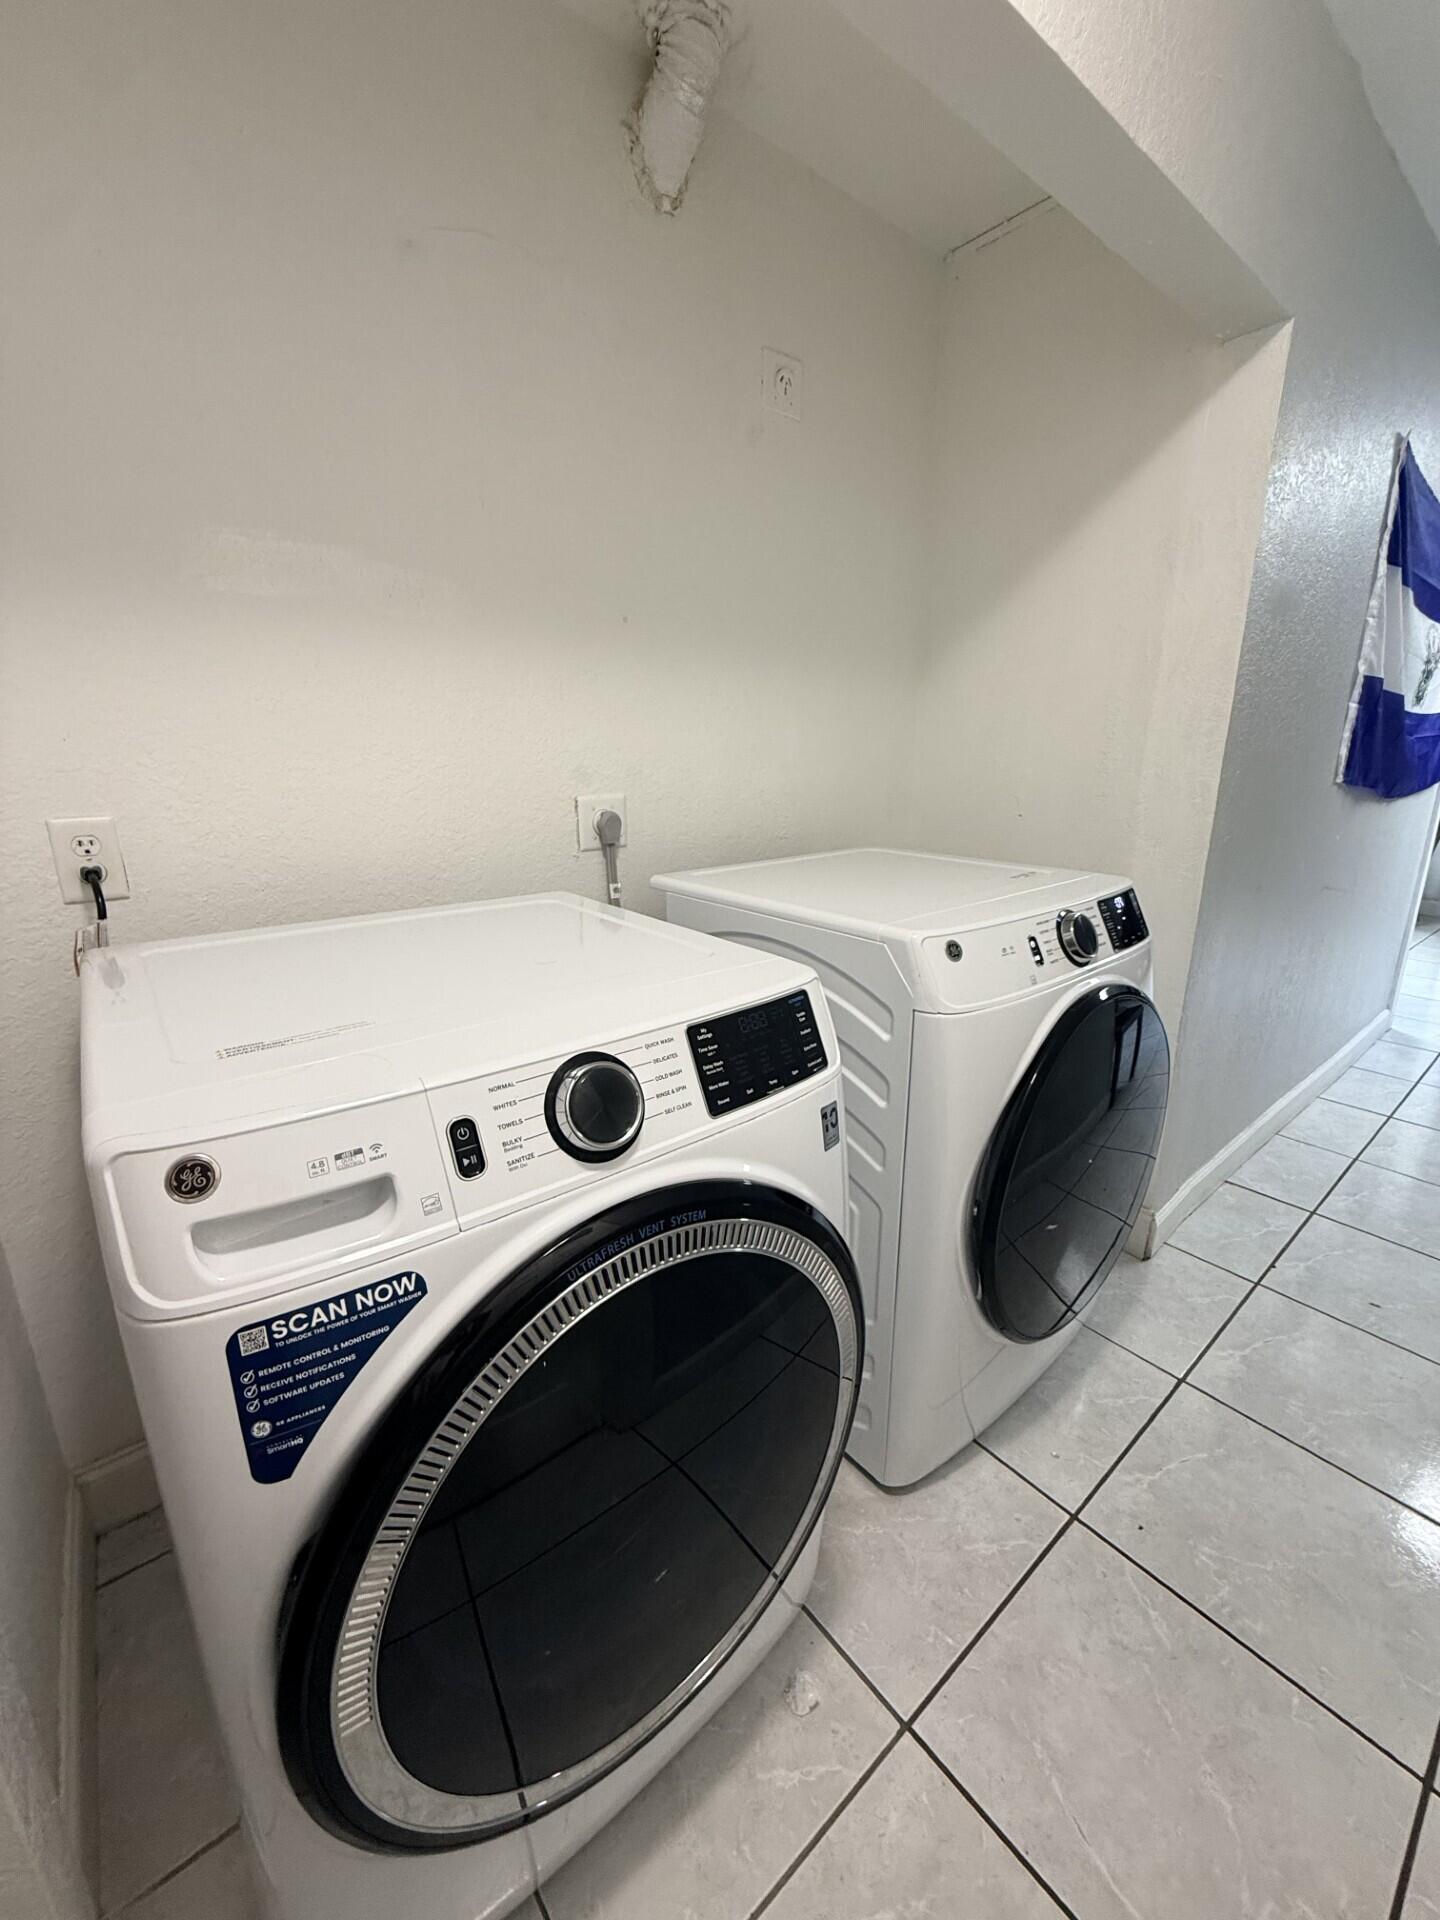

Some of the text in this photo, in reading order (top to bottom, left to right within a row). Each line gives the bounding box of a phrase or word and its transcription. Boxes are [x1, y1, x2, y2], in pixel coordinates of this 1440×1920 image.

[644, 1037, 675, 1050] QUICK WASH
[652, 1052, 679, 1065] DELICATES
[654, 1069, 683, 1082] COLD WASH
[488, 1081, 516, 1094] NORMAL
[656, 1090, 670, 1099] RINSE
[493, 1099, 518, 1112] WHITES
[664, 1101, 693, 1115] SELF CLEAN
[497, 1118, 524, 1131] TOWELS
[501, 1136, 523, 1148] BULKY
[368, 1152, 388, 1162] SMART
[506, 1152, 536, 1167] SANITIZE
[310, 1160, 326, 1170] 4.8
[180, 1167, 208, 1191] GE
[566, 1208, 707, 1282] ULTRAFRESH VENT SYSTEM
[271, 1272, 417, 1340] SCAN NOW
[275, 1290, 422, 1349] TO UNLOCK THE POWER OF YOUR SMART WASHER
[258, 1361, 292, 1377] REMOTE
[293, 1347, 332, 1366] CONTROL
[340, 1324, 390, 1349] MONITORING
[260, 1353, 357, 1392] RECEIVE NOTIFICATIONS
[262, 1371, 345, 1406] SOFTWARE UPDATES
[286, 1404, 326, 1422] APPLIANCES
[266, 1437, 304, 1455] SmartHQ
